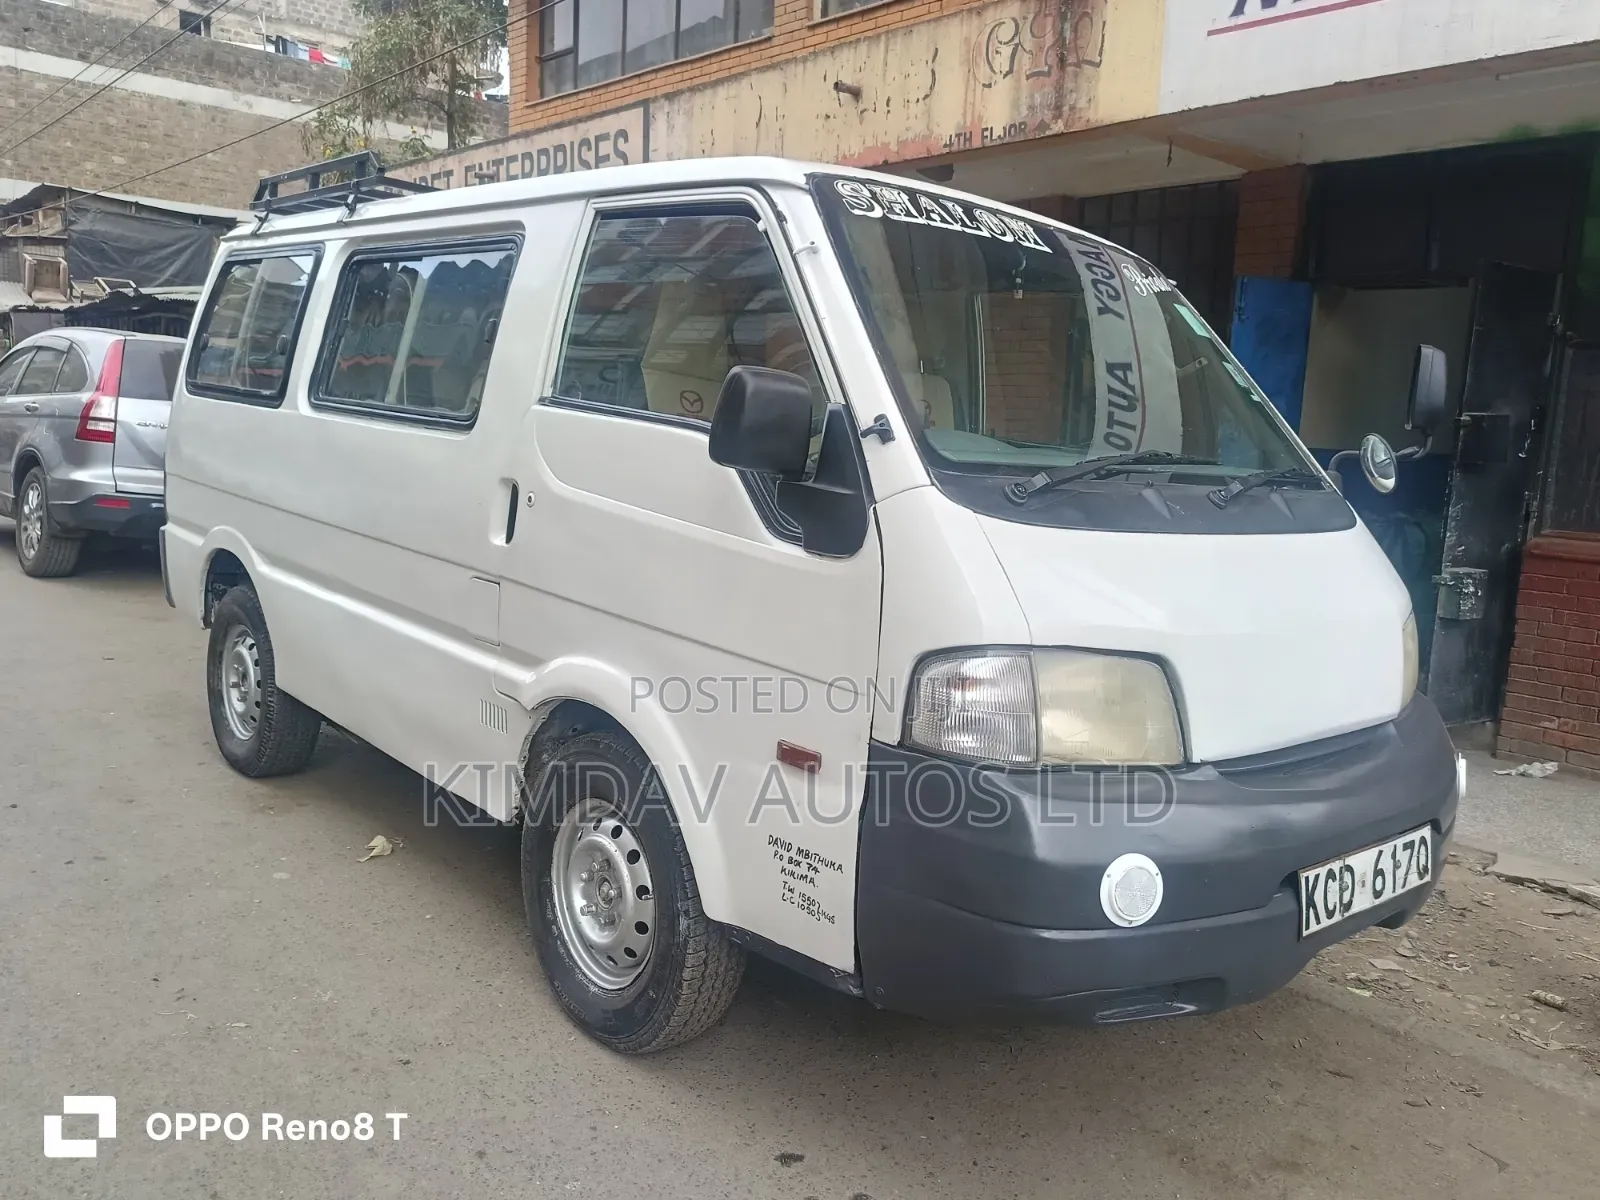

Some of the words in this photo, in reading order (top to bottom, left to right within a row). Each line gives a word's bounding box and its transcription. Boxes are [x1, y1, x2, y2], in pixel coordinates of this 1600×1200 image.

[465, 128, 629, 188] ENTERPRISES
[834, 180, 1053, 254] SHALOM
[768, 834, 793, 853] DAVID
[795, 846, 844, 874] MBITHUKA
[787, 856, 803, 868] BOX
[806, 862, 821, 875] 74
[1304, 864, 1355, 931] KCD
